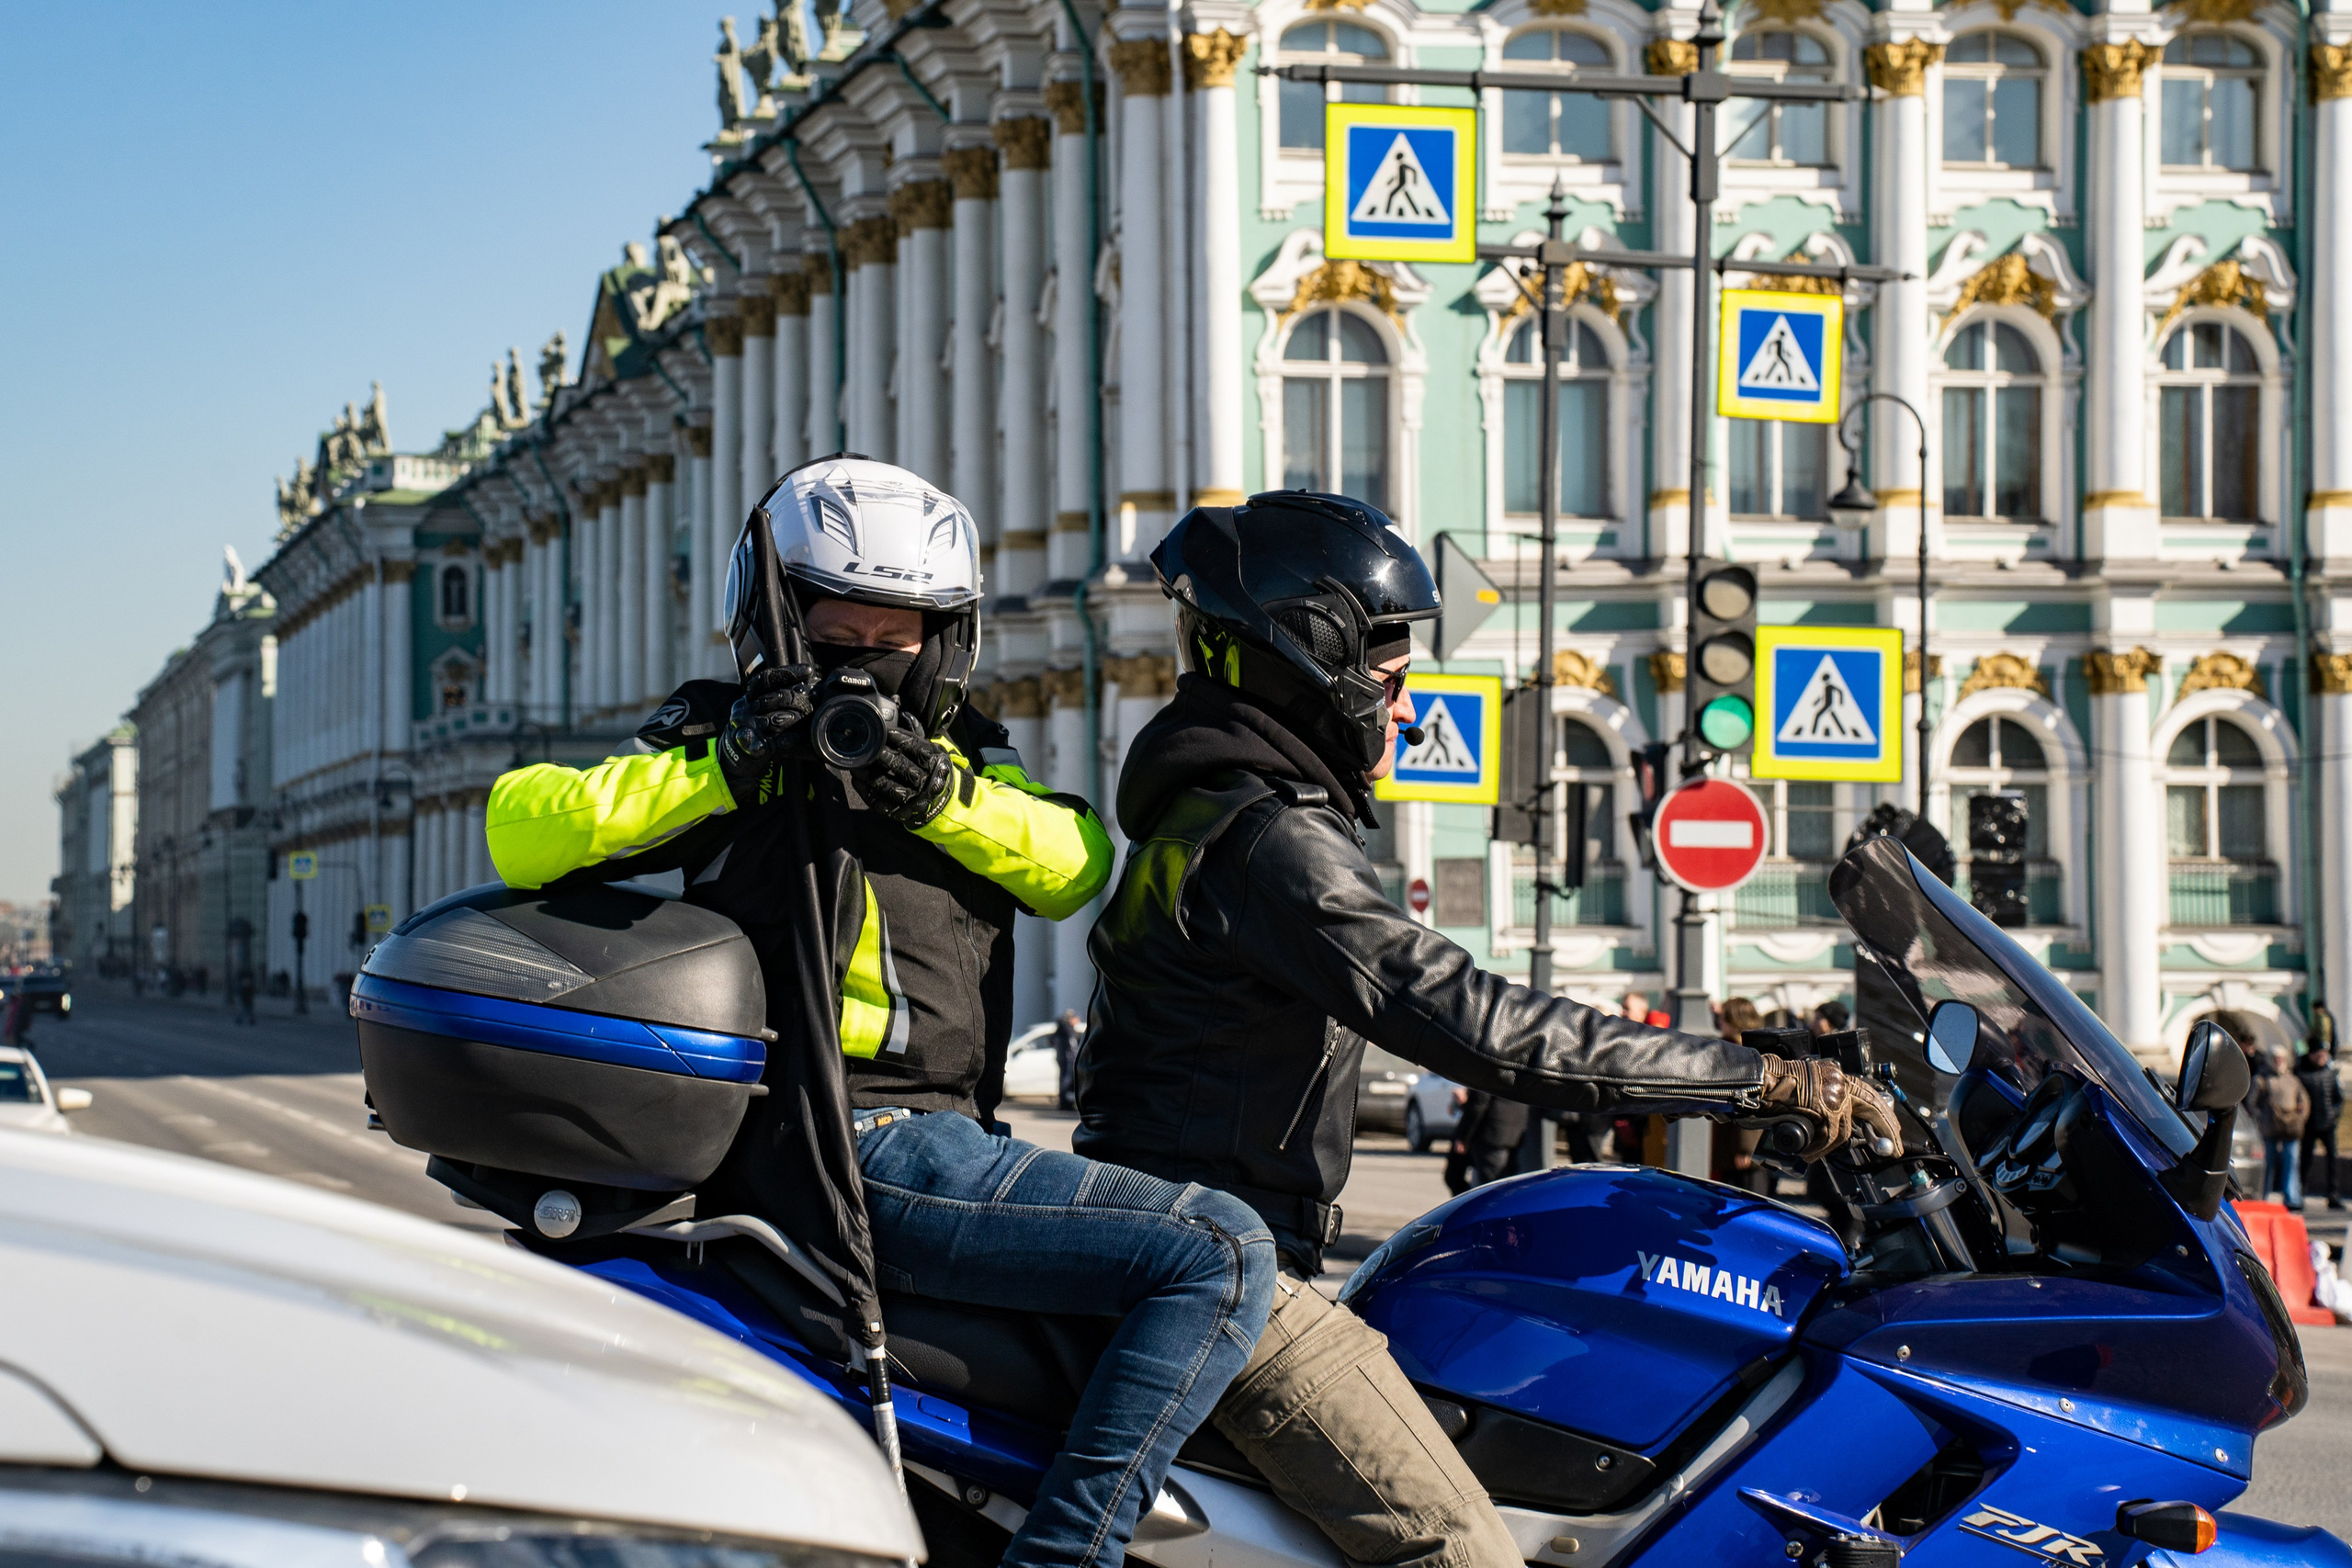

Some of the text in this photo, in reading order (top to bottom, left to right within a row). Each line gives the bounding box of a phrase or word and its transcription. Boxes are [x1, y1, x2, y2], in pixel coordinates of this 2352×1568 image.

[842, 561, 933, 585] LS2
[841, 675, 867, 686] Canon
[1637, 1250, 1782, 1316] YAMAHA
[1962, 1502, 2104, 1566] FJR
